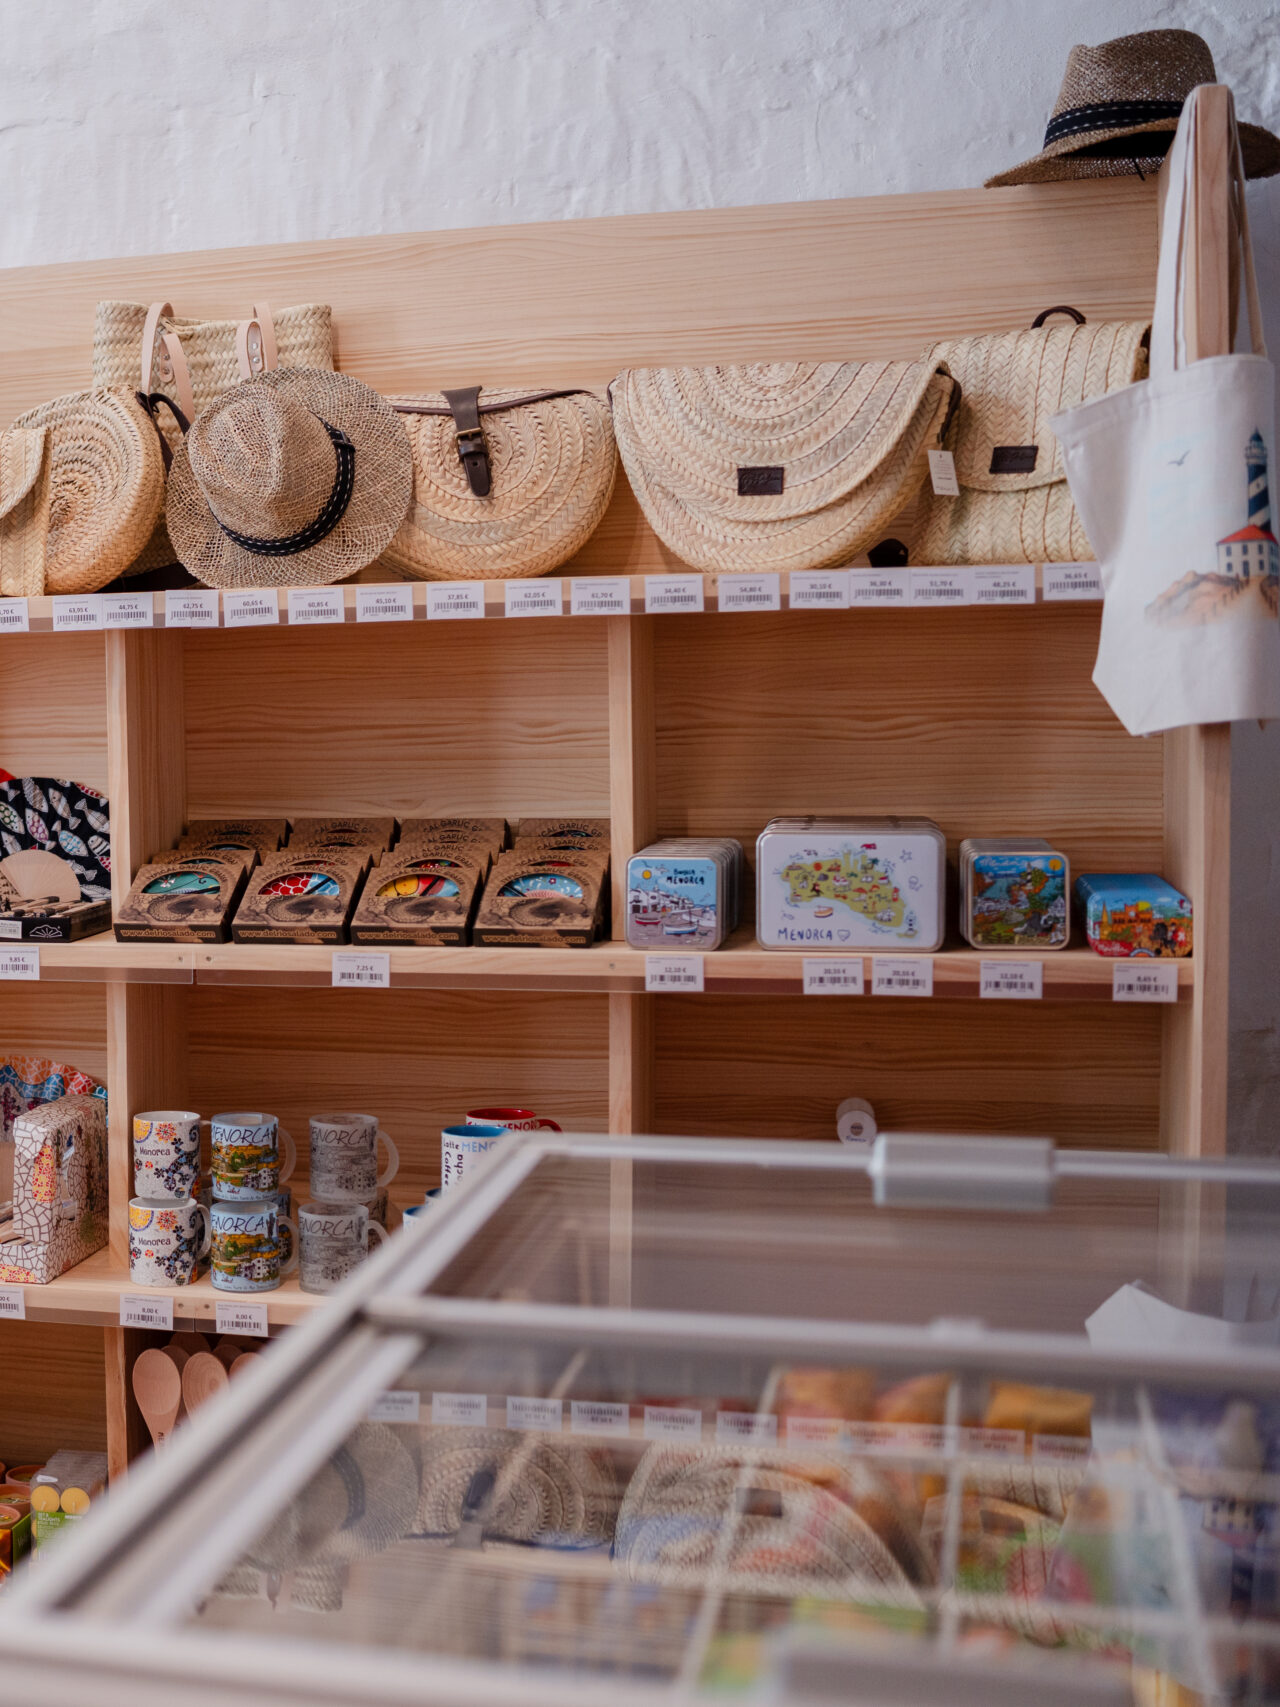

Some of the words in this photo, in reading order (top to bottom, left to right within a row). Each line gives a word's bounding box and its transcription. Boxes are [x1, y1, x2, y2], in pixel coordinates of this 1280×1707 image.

[331, 822, 360, 830] GARLIC
[440, 819, 471, 828] GARLIC
[558, 822, 589, 832] GARLIC
[554, 839, 585, 847] GARLIC
[304, 852, 334, 860] GARLIC
[666, 876, 704, 885] MENORCA
[778, 927, 833, 941] MENORCA
[214, 1126, 270, 1144] ENORCA
[311, 1126, 368, 1146] ENORCA
[211, 1214, 264, 1233] ENORCA
[299, 1217, 354, 1237] ENORCA
